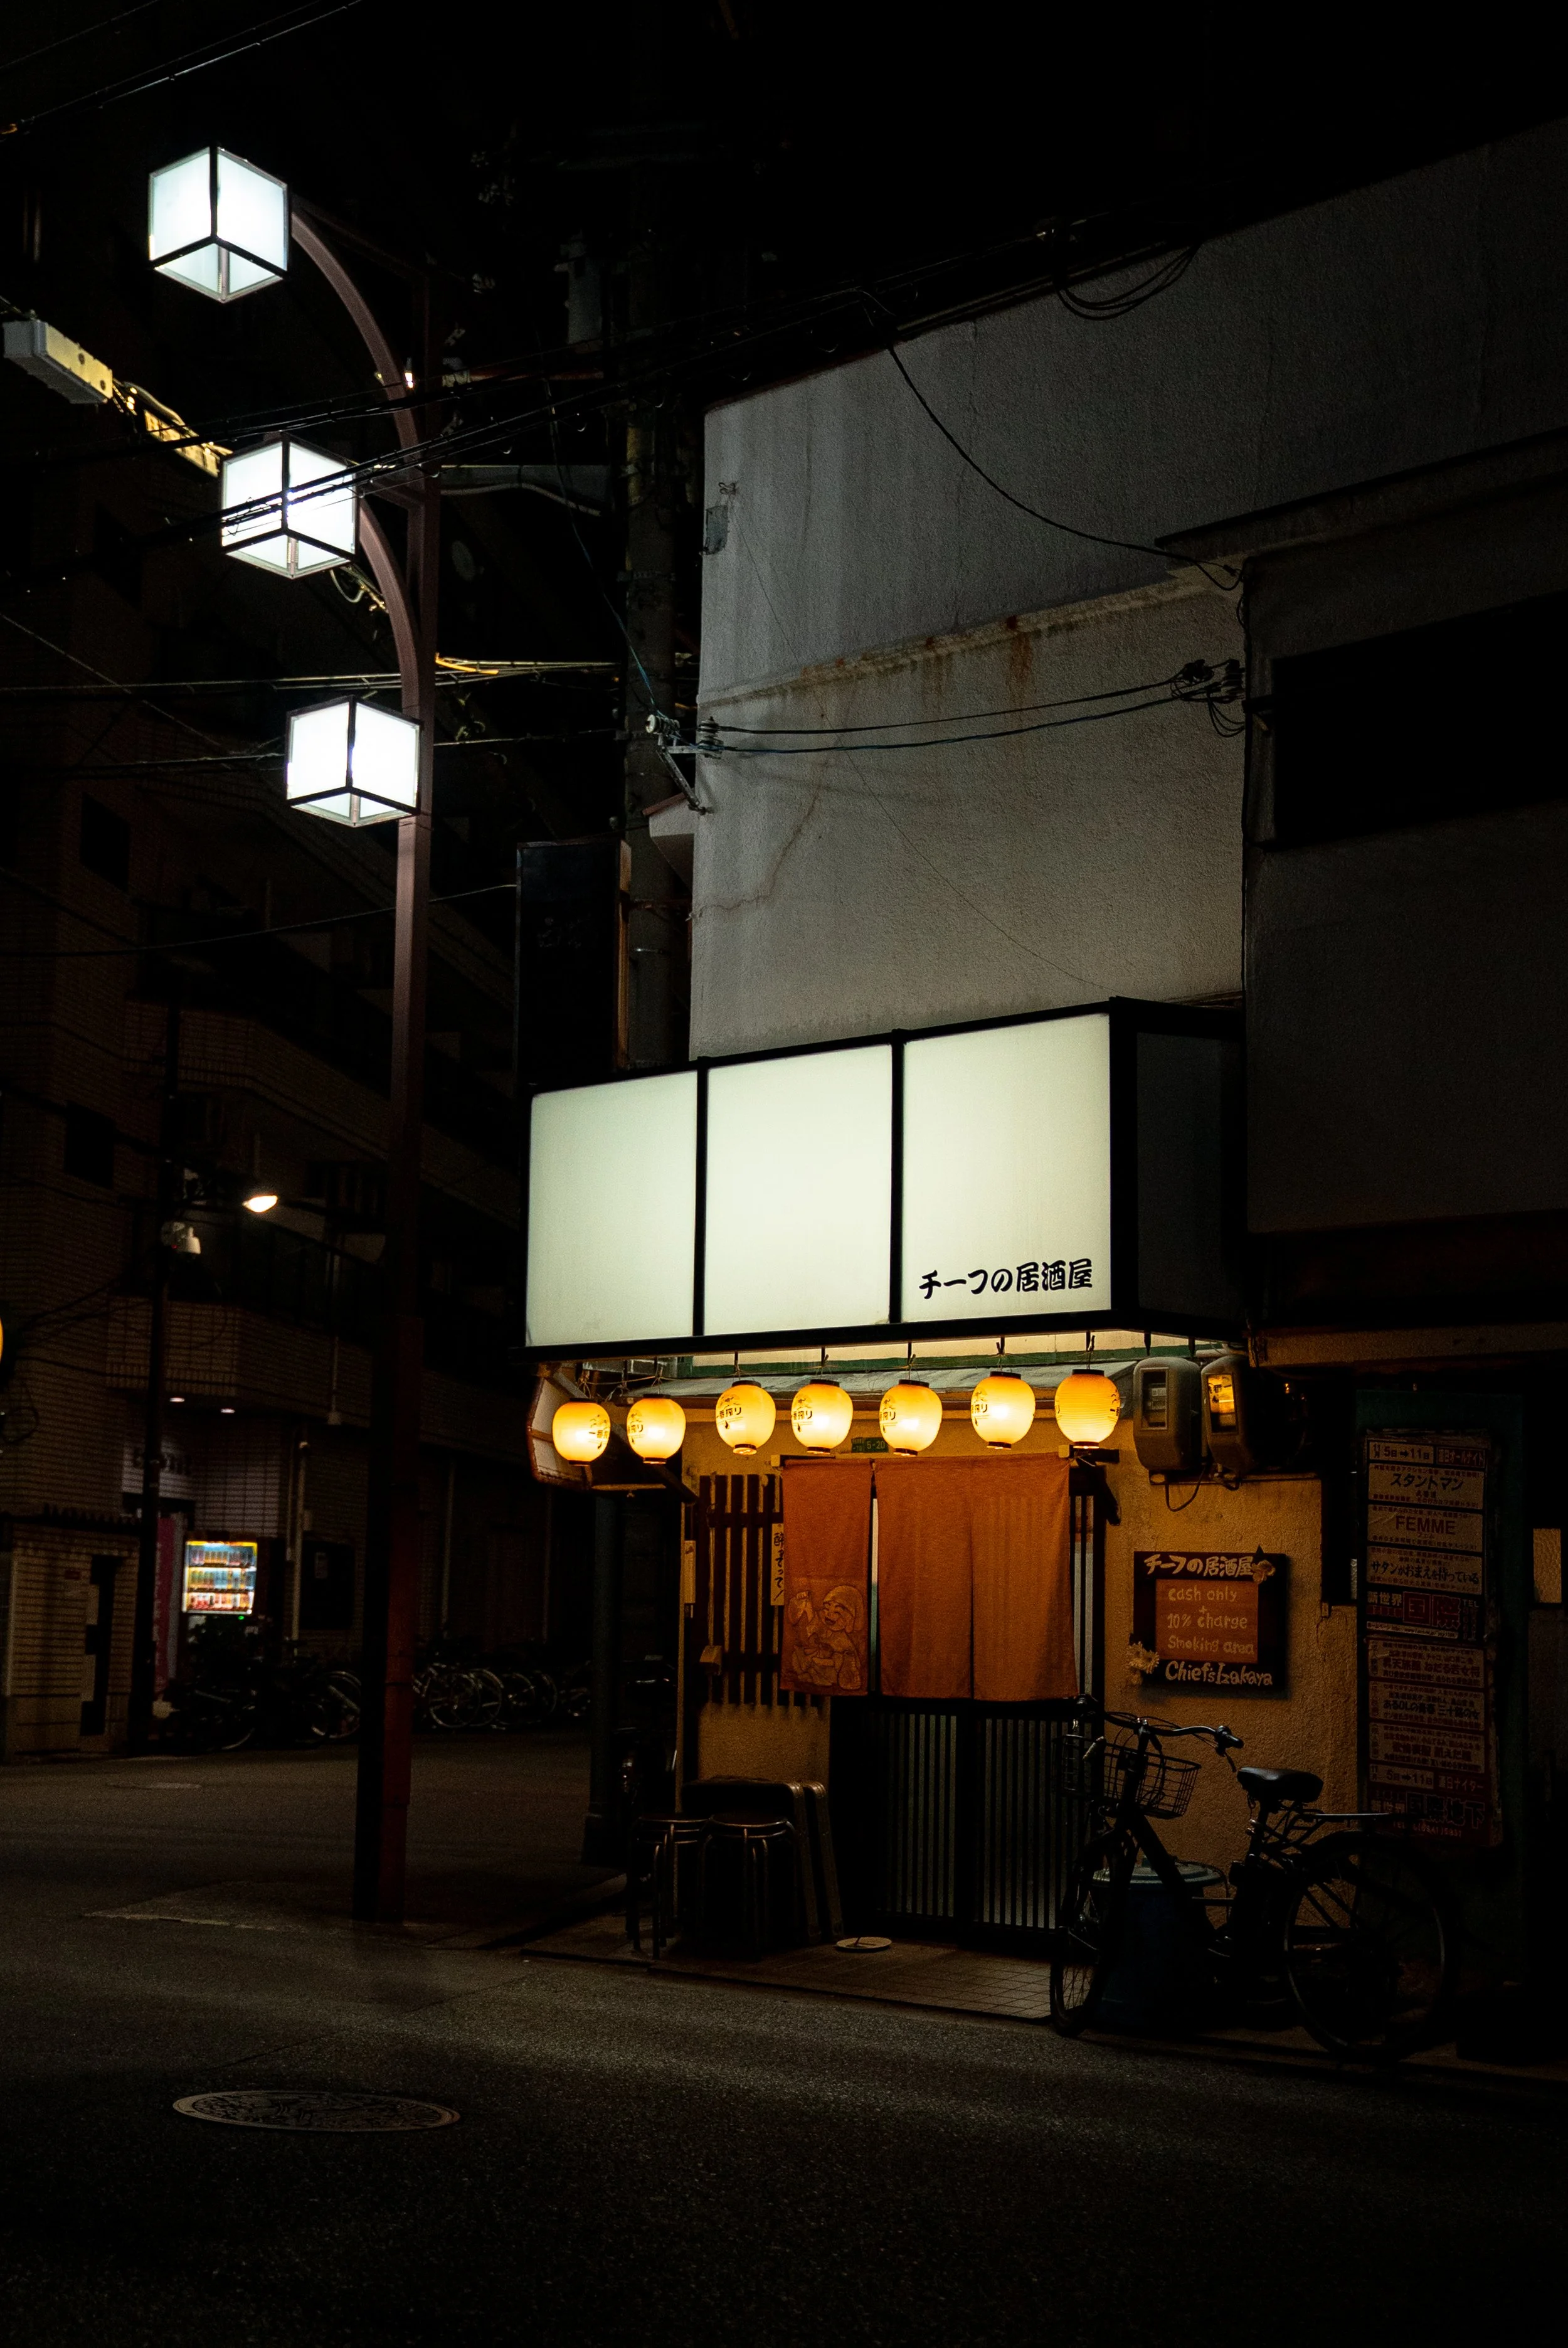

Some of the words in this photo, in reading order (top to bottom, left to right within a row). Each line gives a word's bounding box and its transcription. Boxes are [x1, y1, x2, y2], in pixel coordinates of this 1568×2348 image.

[1391, 1473, 1464, 1491] スタントマン
[1396, 1515, 1456, 1536] FEMME
[1144, 1554, 1255, 1578] チーフの居酒屋
[1207, 1586, 1237, 1602] only
[1463, 1600, 1479, 1608] TEL
[1167, 1613, 1191, 1629] 10%
[1197, 1614, 1248, 1630] charge
[1167, 1635, 1219, 1652] Smoking
[1222, 1641, 1254, 1655] area
